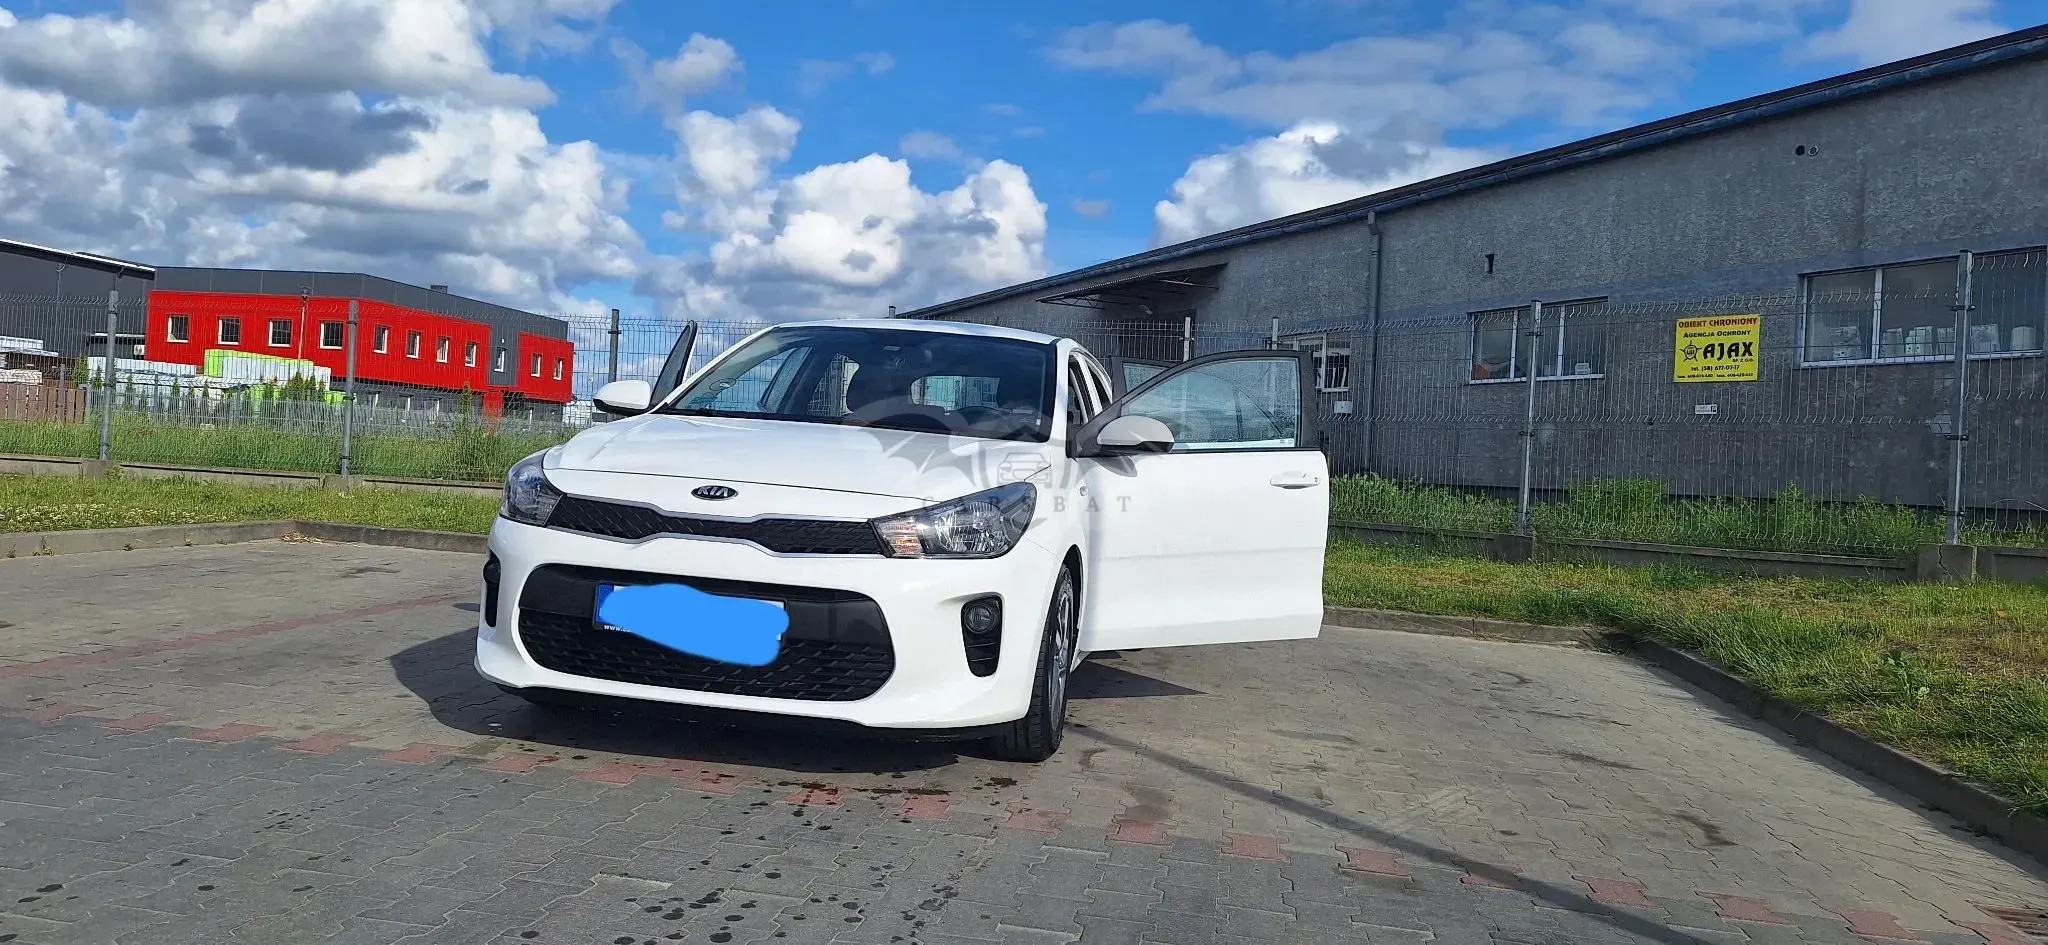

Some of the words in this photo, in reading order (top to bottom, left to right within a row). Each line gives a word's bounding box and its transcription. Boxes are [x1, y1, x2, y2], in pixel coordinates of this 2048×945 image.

[1678, 320, 1707, 328] OBIEKT
[1709, 317, 1758, 327] CHRONIONY
[1703, 341, 1754, 361] AJAX
[697, 486, 729, 497] KIA
